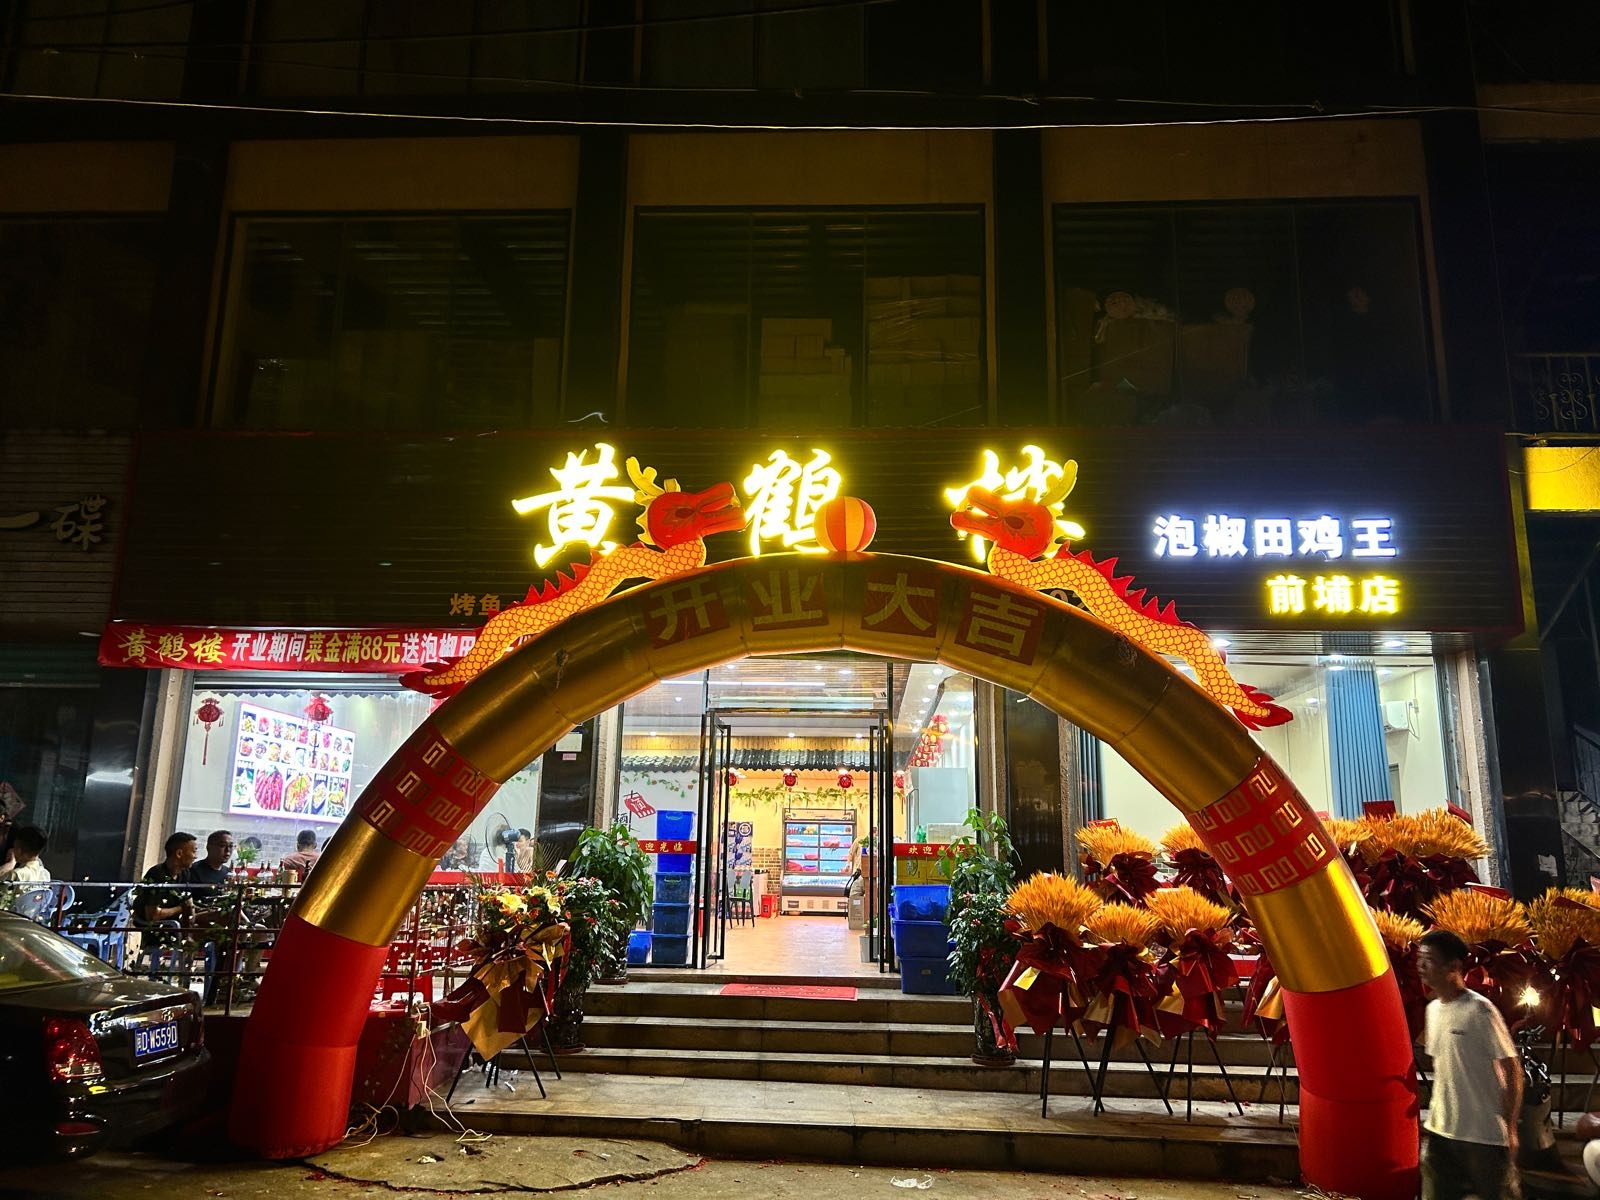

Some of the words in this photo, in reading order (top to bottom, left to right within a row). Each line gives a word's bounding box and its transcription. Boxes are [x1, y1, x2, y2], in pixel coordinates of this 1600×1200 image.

[1153, 514, 1397, 558] 泡椒田鸡王
[449, 592, 501, 617] 烤鱼
[650, 568, 1040, 657] 开业大吉
[1266, 574, 1400, 614] 前埔店
[118, 628, 227, 664] 黄鹤楼
[636, 841, 683, 853] 迎光临
